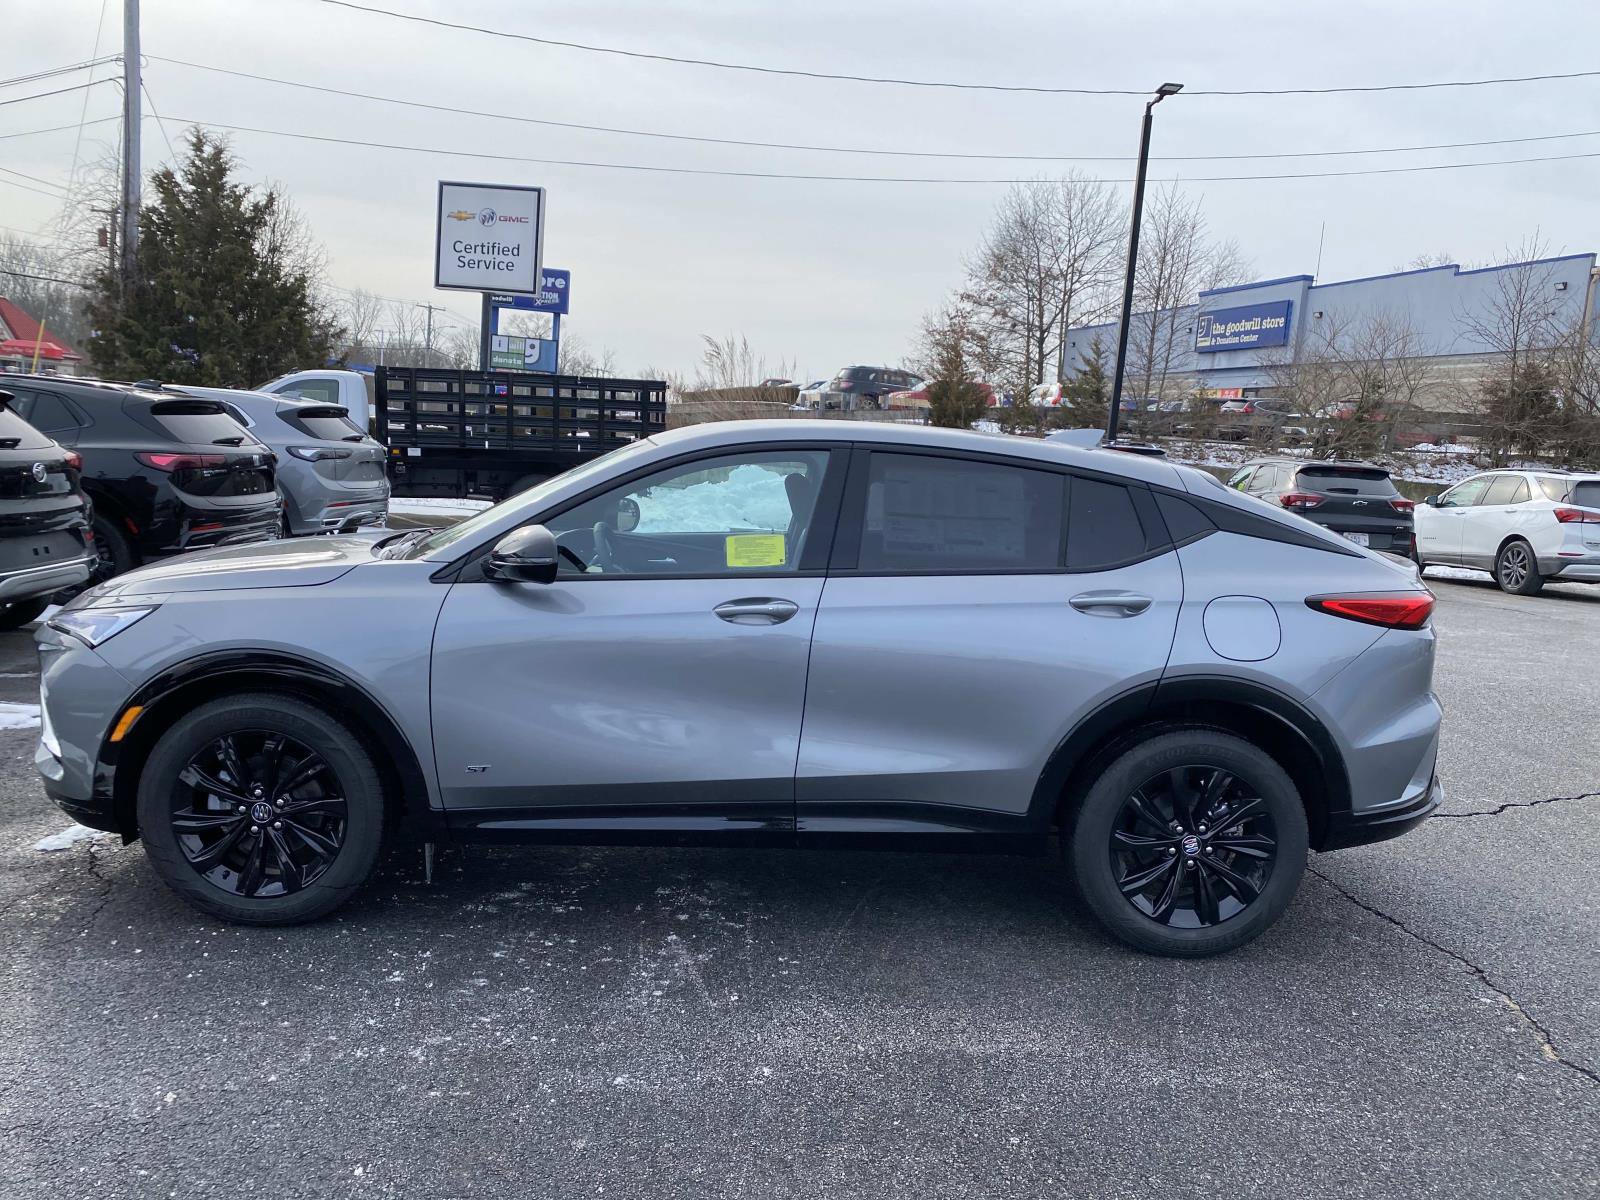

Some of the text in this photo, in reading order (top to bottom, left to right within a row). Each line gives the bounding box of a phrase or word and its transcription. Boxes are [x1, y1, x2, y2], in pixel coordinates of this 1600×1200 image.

[498, 215, 529, 224] GMC
[453, 240, 520, 257] Certified
[457, 255, 515, 272] Service
[1213, 316, 1284, 336] the goodwill store
[1216, 336, 1239, 345] Donation
[1240, 334, 1259, 343] Center
[492, 355, 522, 365] donate
